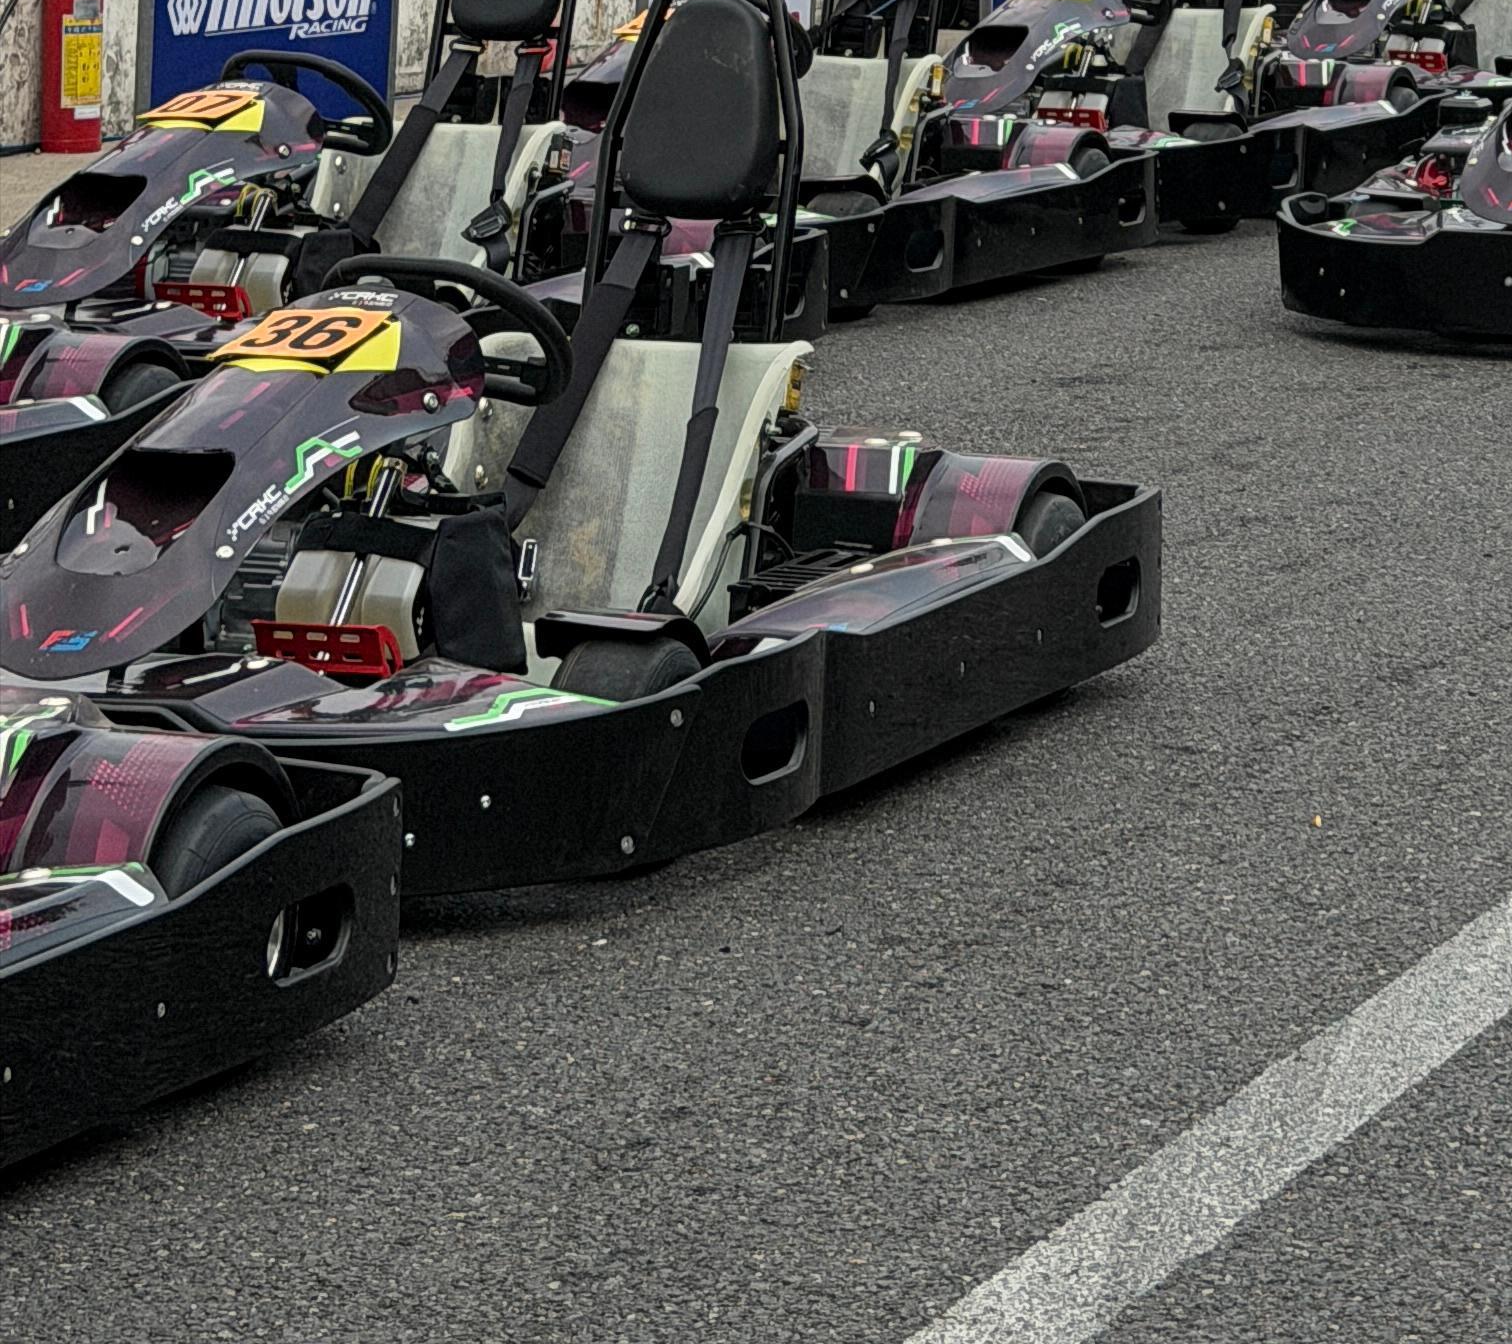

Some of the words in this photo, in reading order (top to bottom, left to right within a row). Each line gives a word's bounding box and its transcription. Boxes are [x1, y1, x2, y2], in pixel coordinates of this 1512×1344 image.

[288, 16, 369, 40] RACING
[156, 94, 243, 113] 07
[239, 315, 362, 350] 36
